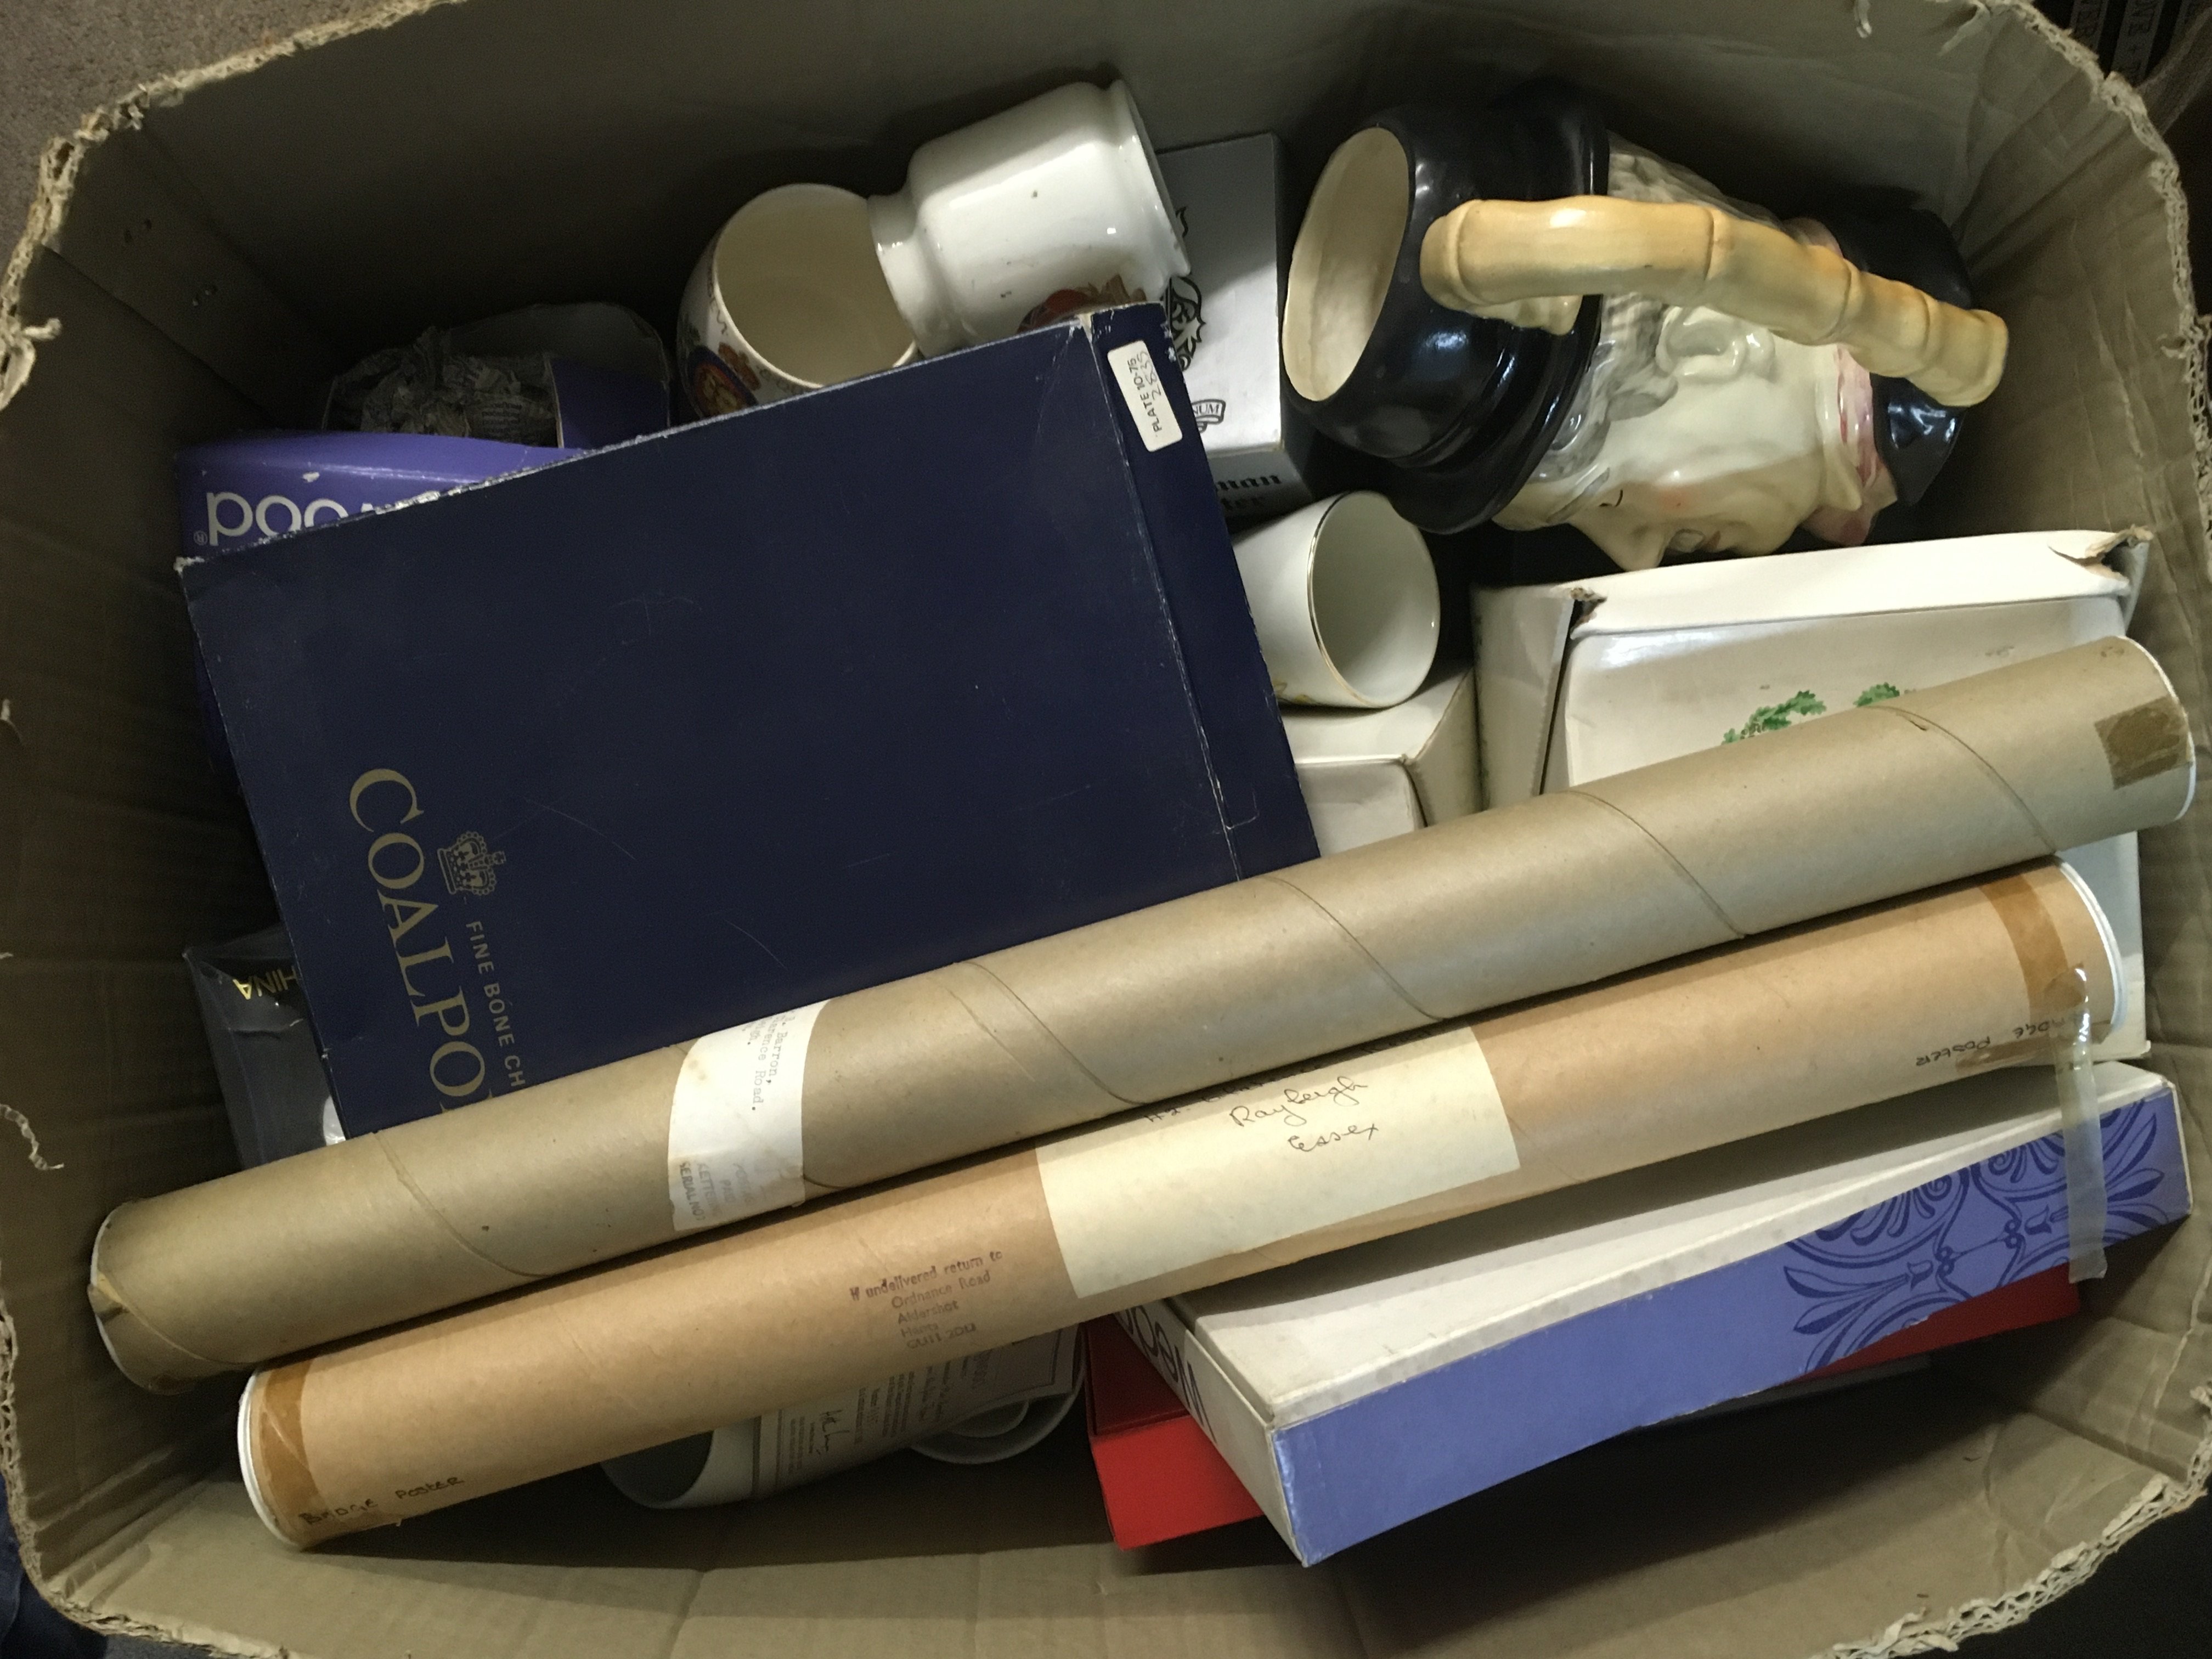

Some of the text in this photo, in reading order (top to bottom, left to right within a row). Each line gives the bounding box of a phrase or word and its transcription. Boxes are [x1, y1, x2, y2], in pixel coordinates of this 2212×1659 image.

[1127, 358, 1163, 433] PLATE 10-75
[349, 768, 494, 1114] COALPO
[466, 921, 494, 975] FINE
[484, 983, 515, 1048] BONE
[766, 1031, 788, 1084] Barron,
[752, 1070, 766, 1111] Road.
[1287, 1123, 1379, 1153] Essex
[679, 1161, 696, 1201] SERIAL
[865, 1265, 938, 1298] undelivered
[944, 1256, 984, 1275] return
[989, 1250, 1003, 1262] to
[891, 1270, 991, 1308] Ordnance Road
[898, 1300, 960, 1324] Aldershot
